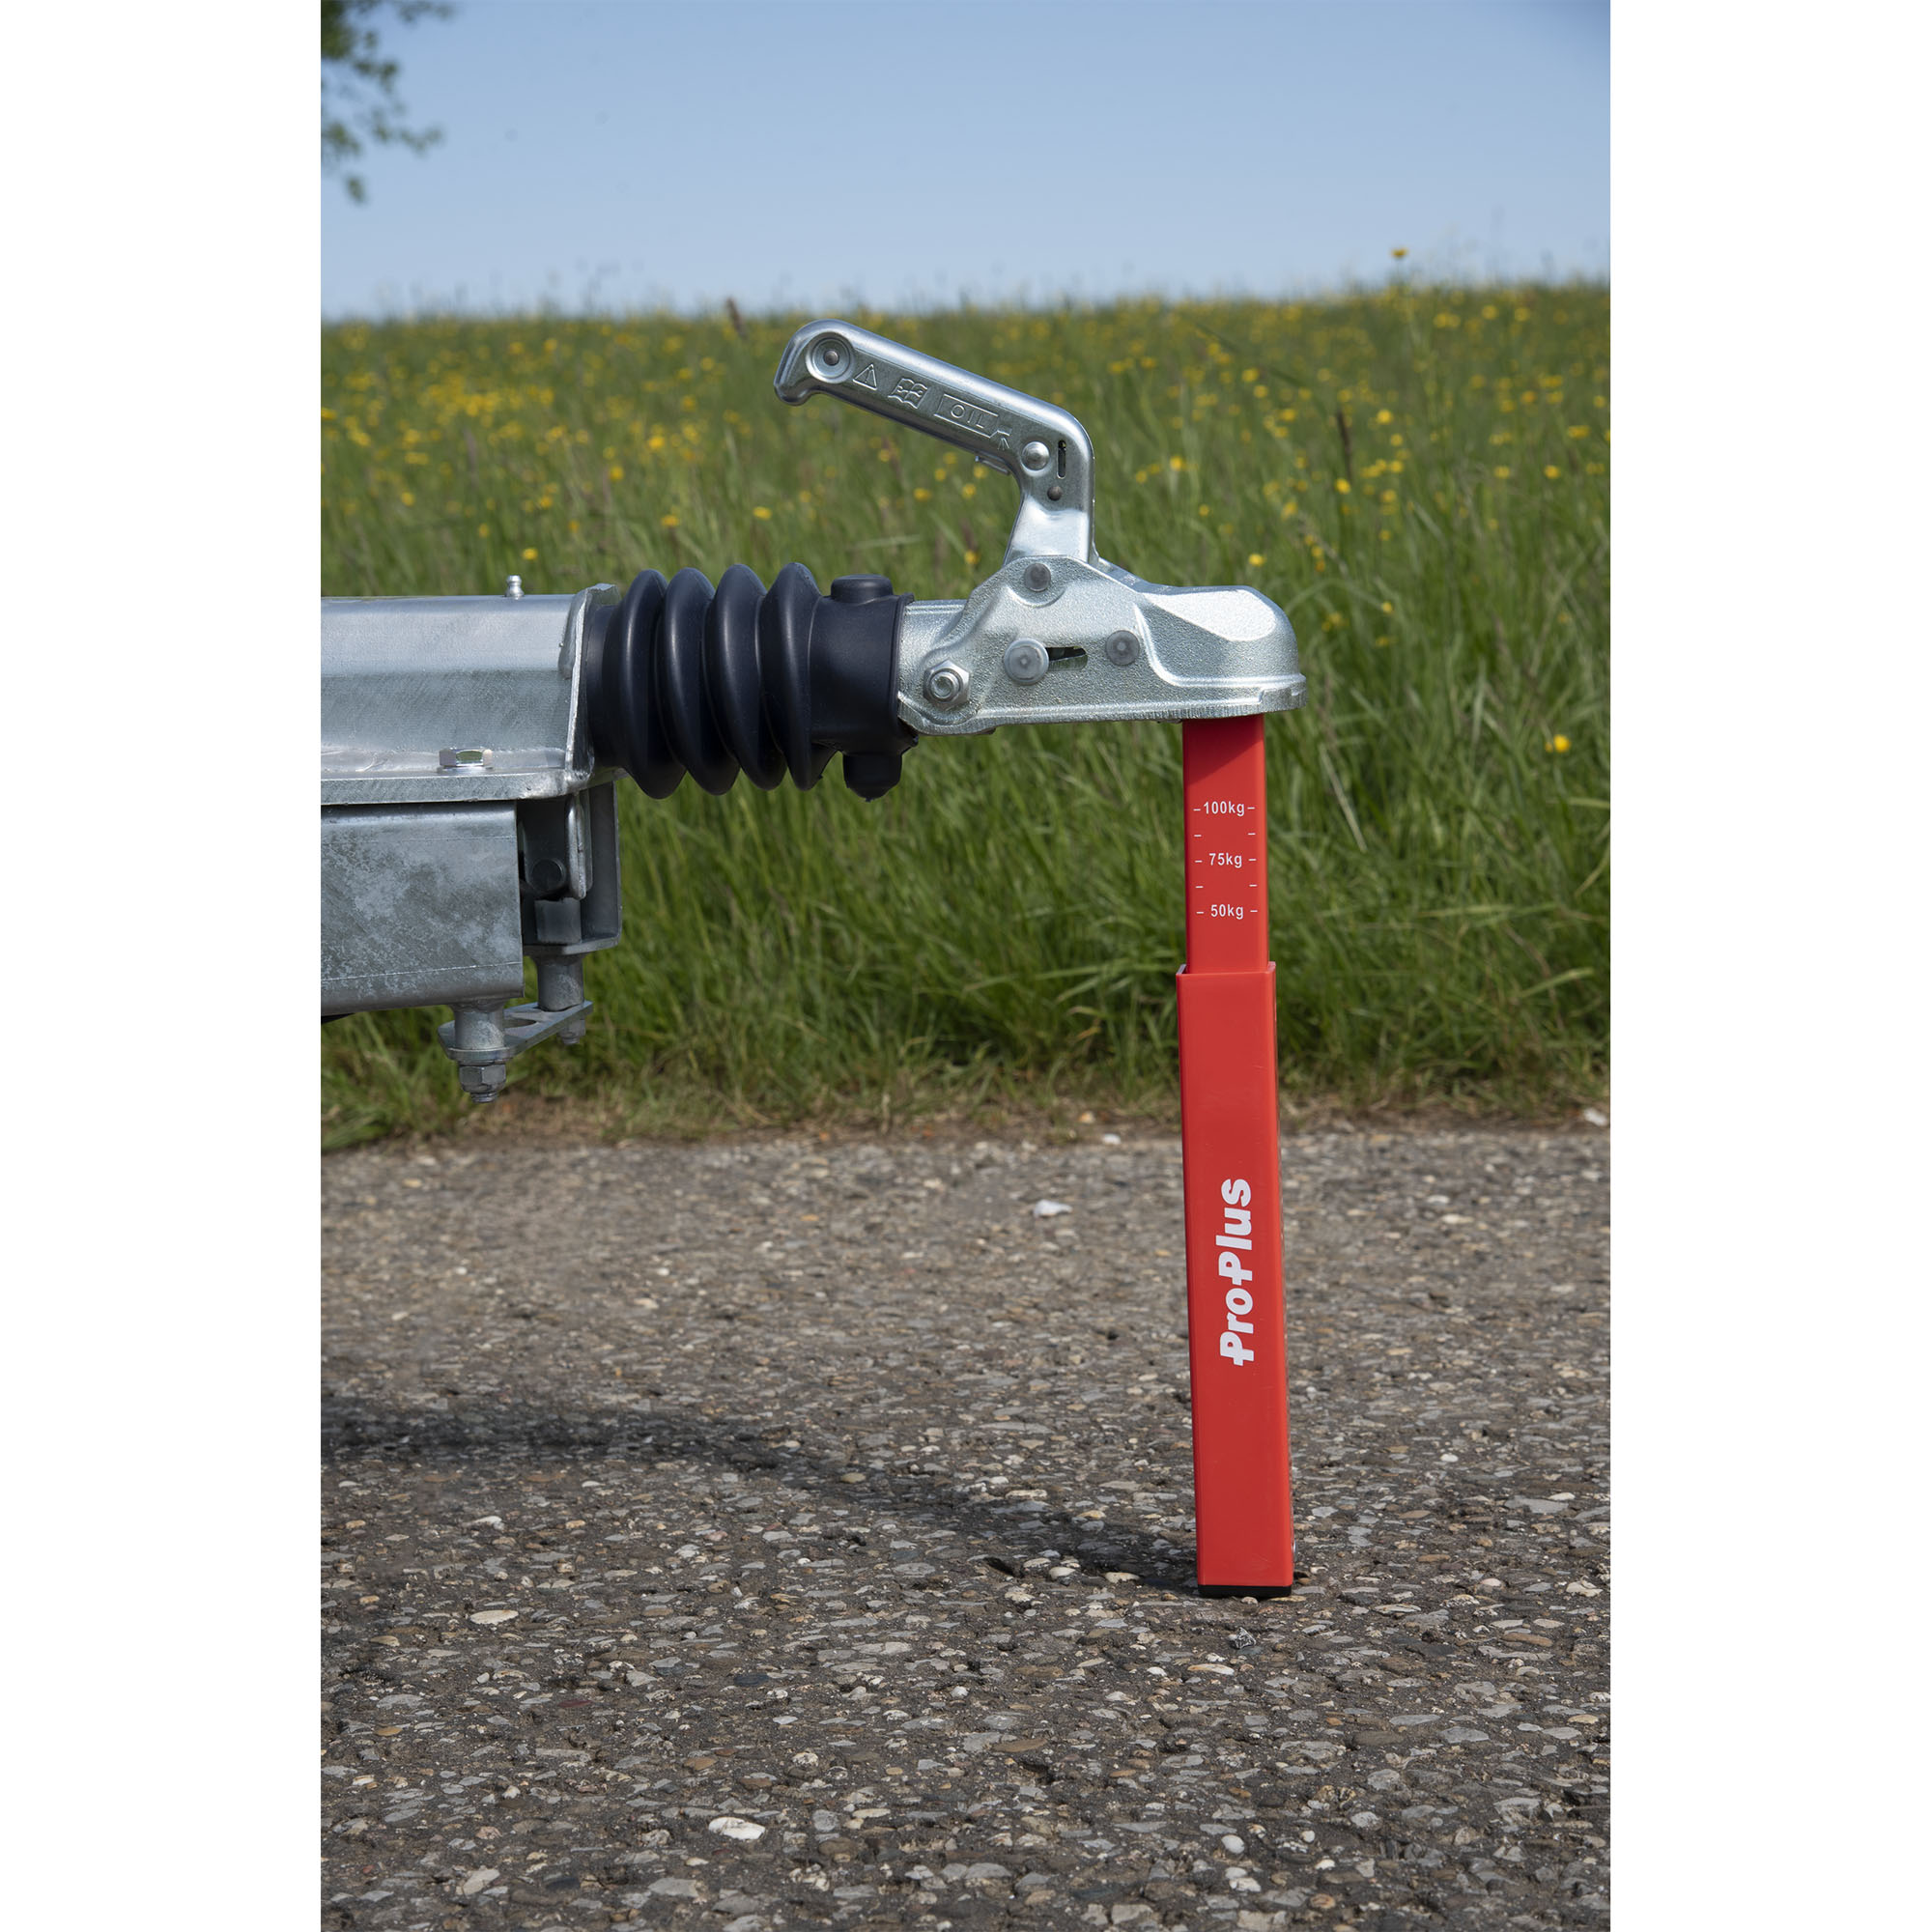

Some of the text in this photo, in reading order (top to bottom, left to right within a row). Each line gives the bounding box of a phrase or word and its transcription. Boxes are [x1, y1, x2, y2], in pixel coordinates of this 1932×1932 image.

[950, 403, 984, 429] OIL
[1203, 801, 1245, 817] 100kg
[1208, 853, 1242, 869] 75kg
[1210, 904, 1244, 921] 50kg
[1215, 1179, 1255, 1367] ProPlus
